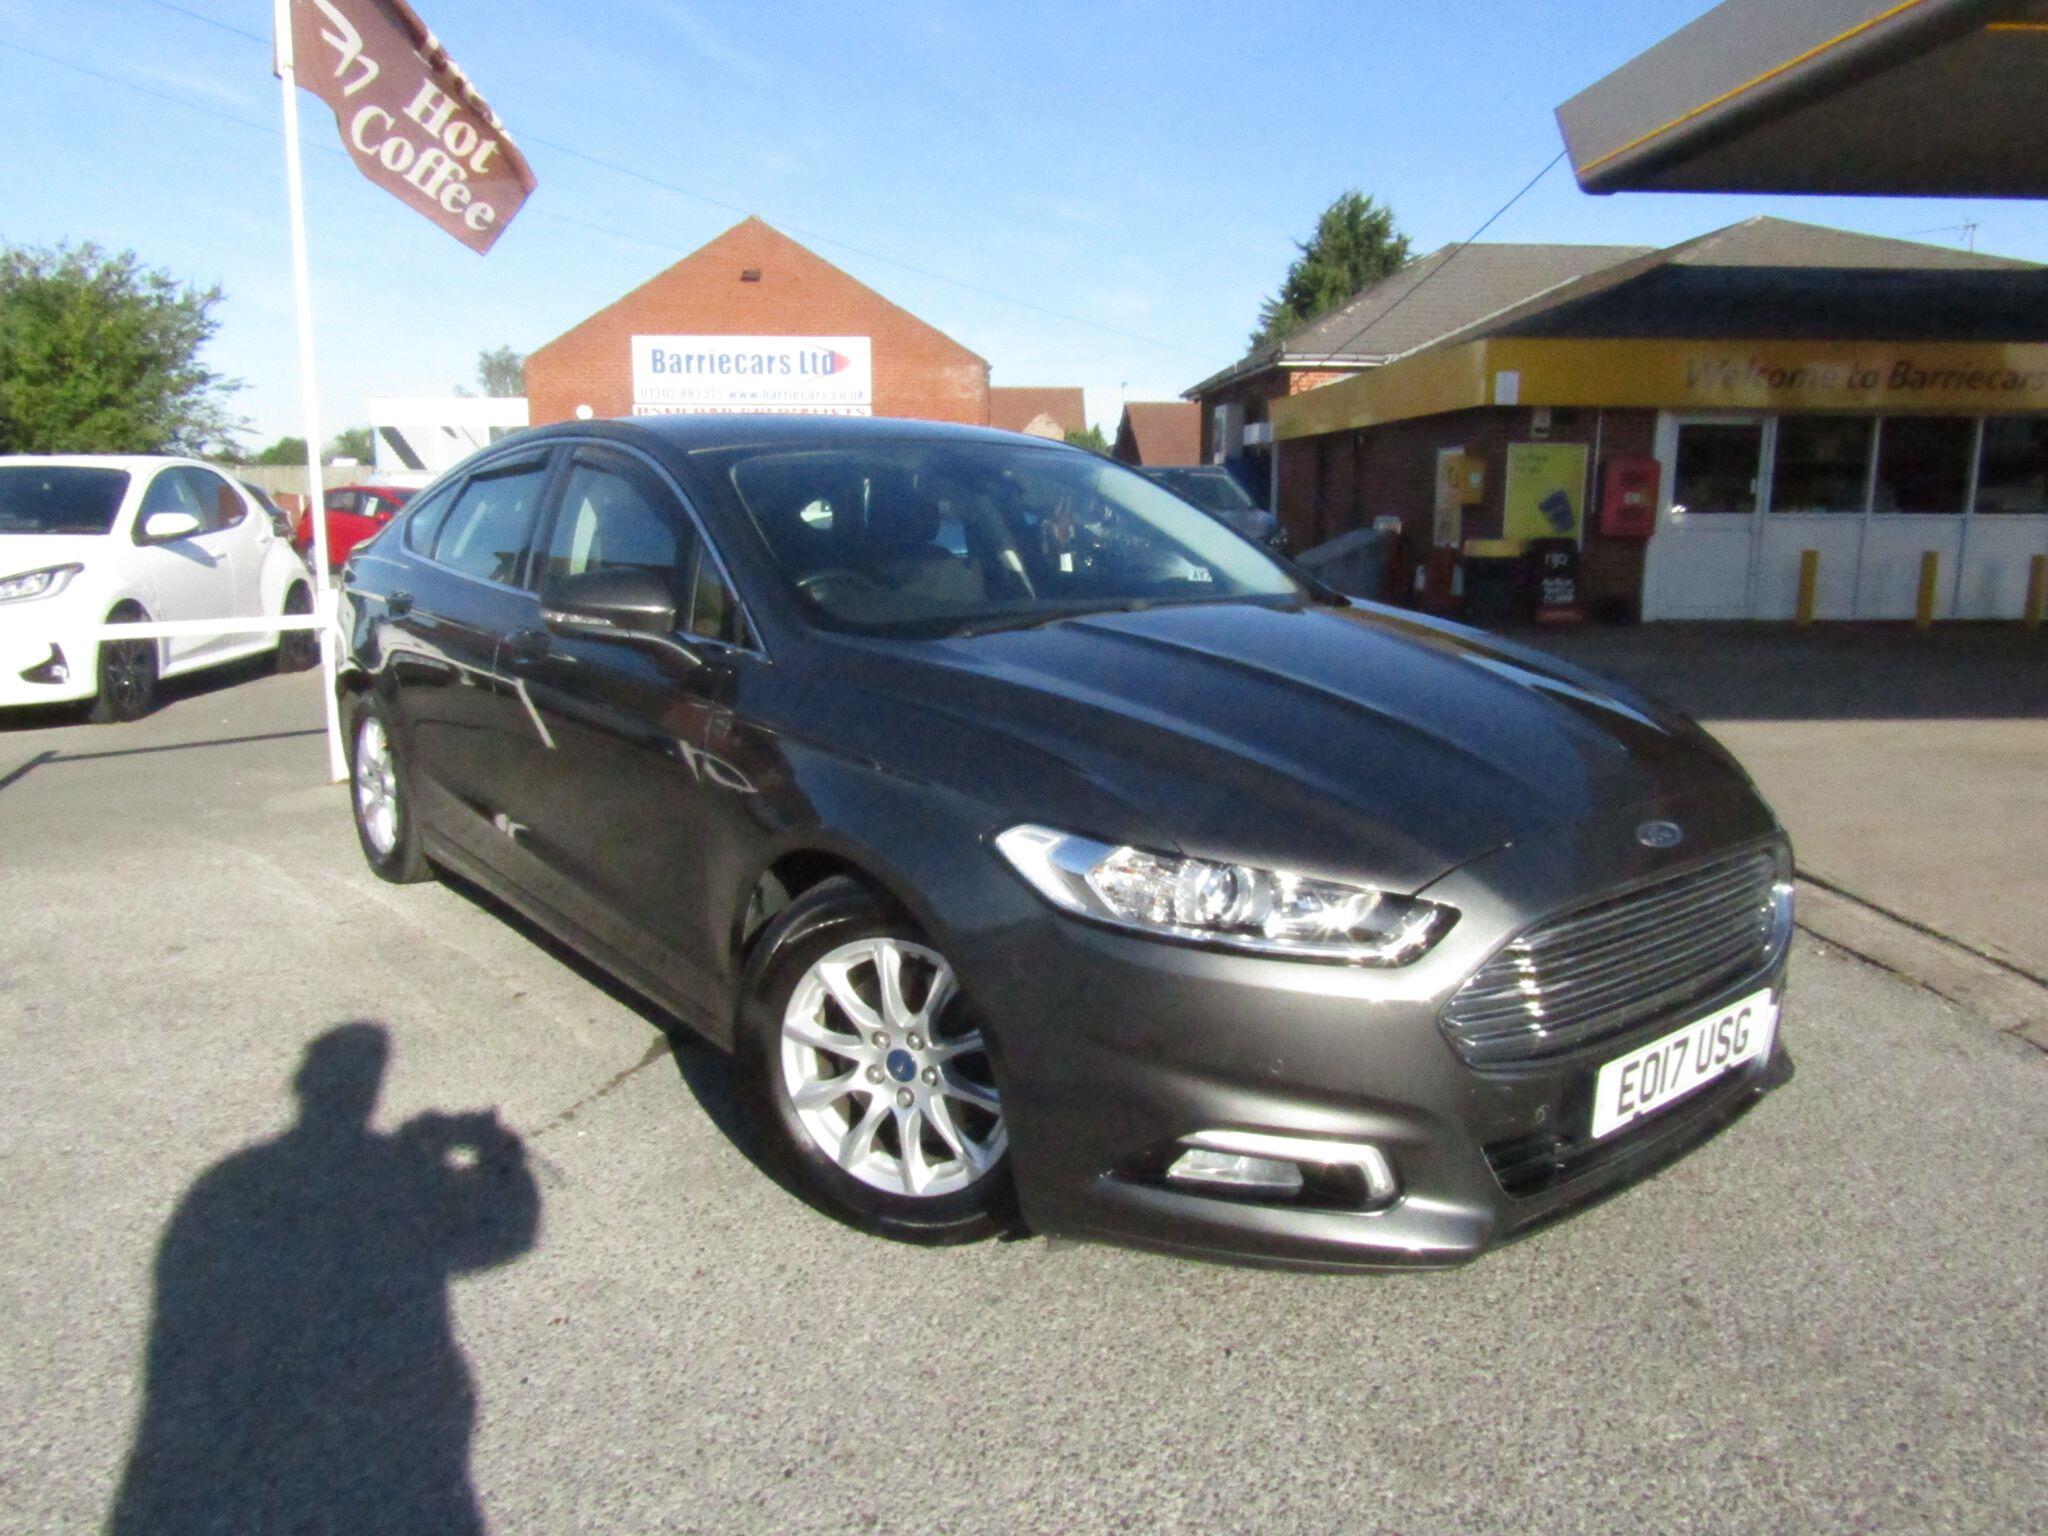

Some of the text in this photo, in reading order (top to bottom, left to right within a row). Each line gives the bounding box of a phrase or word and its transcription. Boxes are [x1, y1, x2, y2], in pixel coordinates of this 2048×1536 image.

[402, 78, 499, 173] Hot
[352, 105, 496, 231] Coffee
[651, 348, 836, 376] Barriecars Ltd
[1685, 359, 1839, 390] Welcome
[1847, 359, 1881, 390] to
[1695, 1007, 1752, 1075] USG
